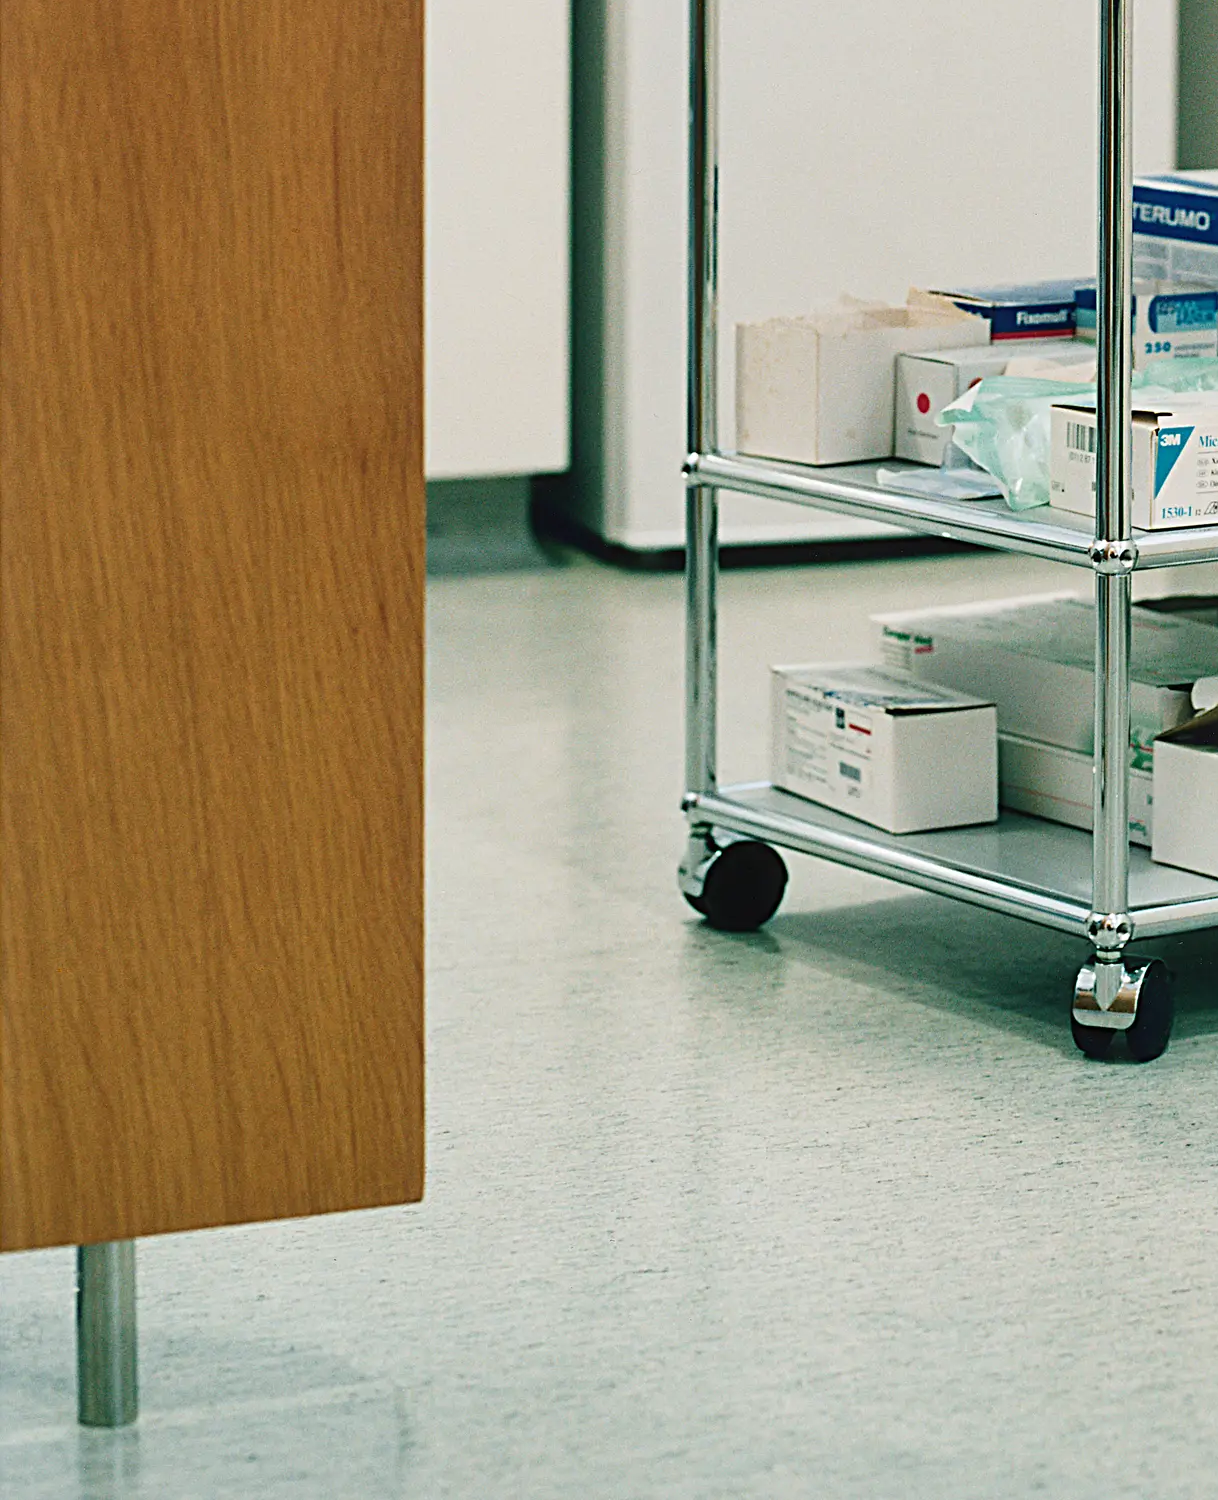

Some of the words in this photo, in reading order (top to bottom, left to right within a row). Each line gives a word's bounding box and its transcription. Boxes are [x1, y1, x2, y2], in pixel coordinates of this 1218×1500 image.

[1145, 341, 1171, 354] 250
[1160, 433, 1180, 447] 3M
[1162, 506, 1192, 519] 1530-1
